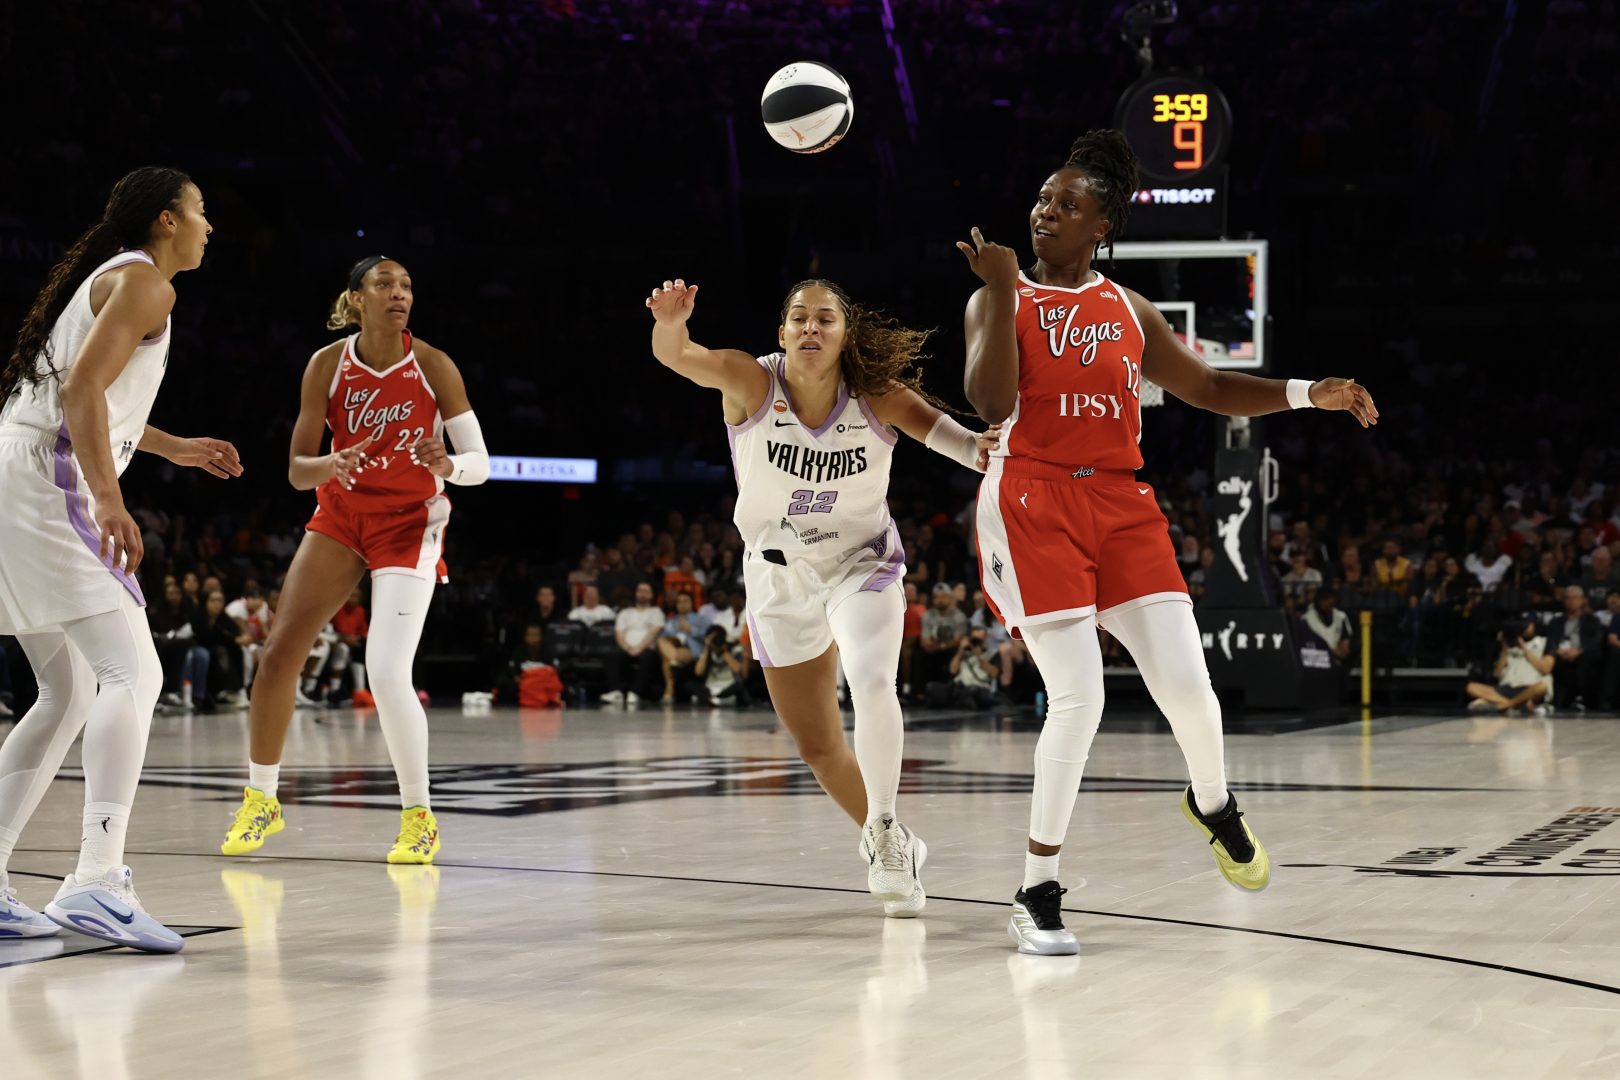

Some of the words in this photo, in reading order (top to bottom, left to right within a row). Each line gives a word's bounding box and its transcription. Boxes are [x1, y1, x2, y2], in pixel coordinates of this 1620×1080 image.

[1153, 93, 1208, 122] 3:59
[1173, 121, 1203, 169] 9
[1151, 188, 1215, 203] TISSOT
[1099, 290, 1118, 302] ally
[1038, 303, 1068, 330] Las
[1048, 303, 1126, 366] Vegas
[402, 369, 419, 380] ally
[344, 386, 371, 410] Las
[1058, 393, 1125, 420] IPSY
[347, 387, 416, 442] Vegas
[393, 426, 425, 452] 22
[766, 440, 868, 484] VALKYRIES
[1071, 466, 1096, 479] Aces
[1217, 476, 1253, 498] ally
[787, 489, 839, 516] 22
[799, 527, 819, 538] KAISER
[801, 531, 840, 545] ERMANNTE
